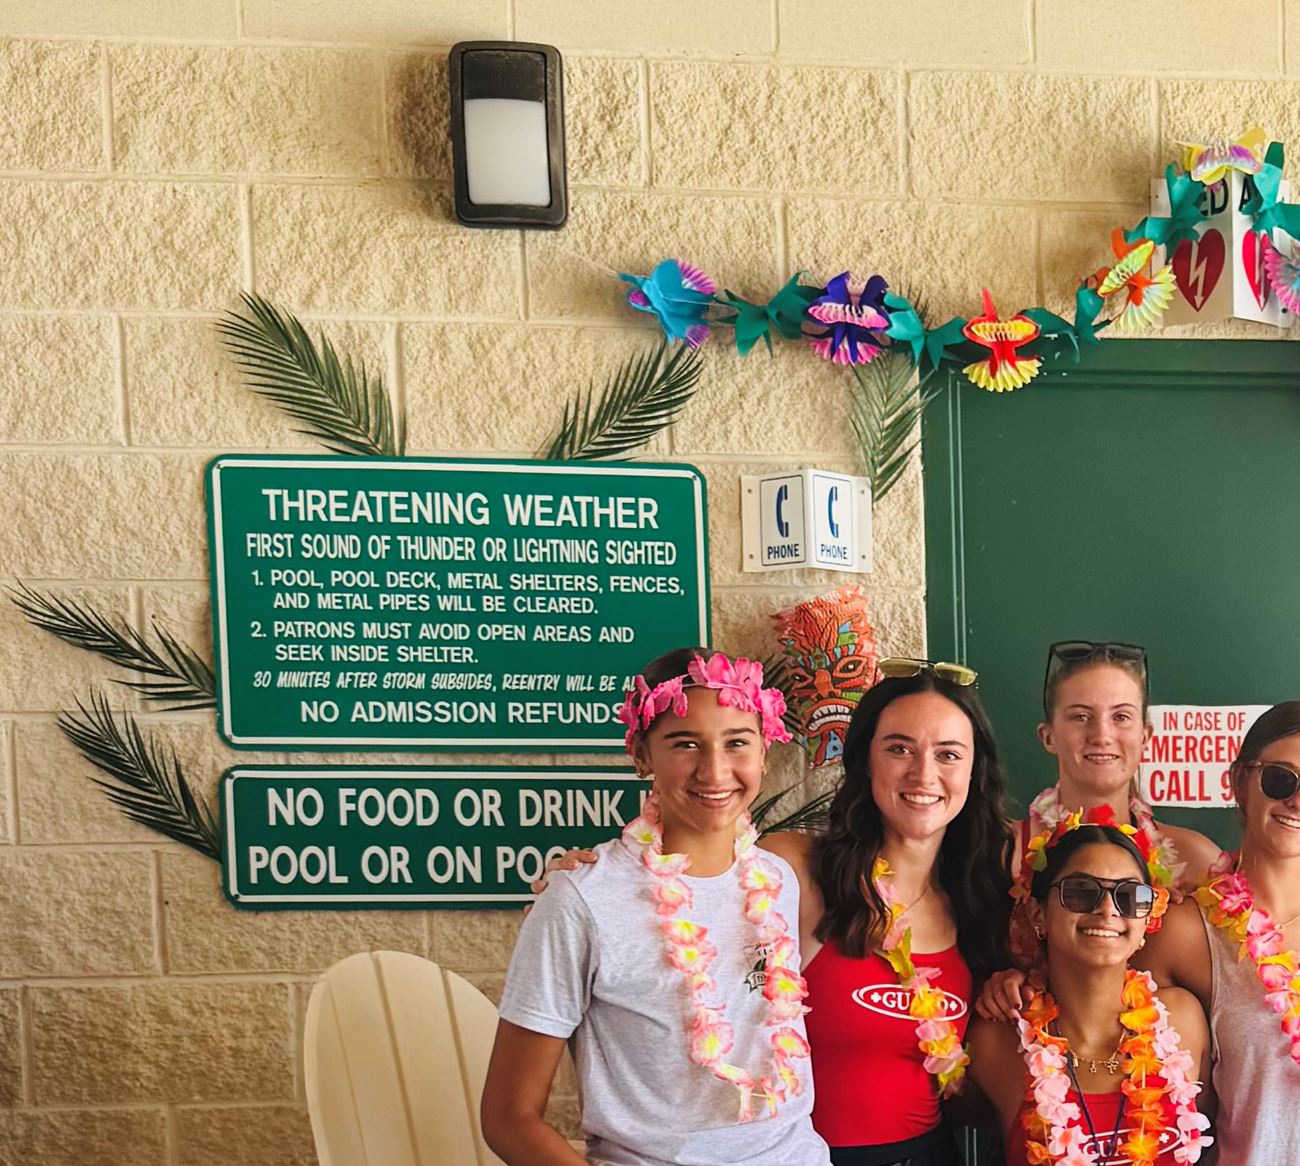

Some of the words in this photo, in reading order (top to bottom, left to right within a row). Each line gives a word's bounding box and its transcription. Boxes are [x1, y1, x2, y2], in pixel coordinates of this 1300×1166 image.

[261, 488, 490, 526] THREATENING
[503, 493, 659, 529] WEATHER
[246, 532, 294, 558] FIRST
[300, 533, 362, 559] SOUND
[367, 534, 391, 560] OF
[396, 535, 476, 561] THUNDER
[482, 537, 508, 562] OR
[513, 537, 599, 564] LIGHTNING
[605, 539, 677, 566] SIGHTED
[767, 543, 800, 560] PHONE
[820, 543, 848, 560] PHONE
[251, 569, 264, 586] 1.
[271, 569, 324, 589] POOL,
[331, 570, 380, 588] POOL
[386, 571, 441, 591] DECK,
[447, 572, 503, 590] METAL
[509, 573, 603, 594] SHELTERS,
[609, 575, 685, 596] FENCES,
[273, 592, 310, 609] AND
[317, 592, 374, 610] METAL
[379, 593, 431, 612] PIPES
[436, 594, 477, 612] WILL
[482, 595, 507, 613] BE
[513, 595, 598, 614] CLEARED.
[250, 620, 267, 638] 2.
[273, 620, 356, 639] PATRONS
[362, 622, 412, 640] MUST
[418, 623, 471, 640] AVOID
[477, 623, 526, 641] OPEN
[532, 625, 592, 643] AREAS
[598, 626, 635, 643] AND
[275, 644, 324, 661] SEEK
[331, 644, 390, 662] INSIDE
[396, 645, 479, 663] SHELTER.
[253, 670, 272, 688] 30
[276, 671, 331, 689] MINUTES
[336, 671, 378, 689] AFTER
[382, 672, 426, 689] STORM
[430, 672, 497, 692] SUBSIDES,
[502, 673, 561, 691] REENTRY
[566, 674, 595, 692] WILL
[598, 675, 617, 692] BE
[301, 700, 340, 723] NO
[350, 700, 497, 723] ADMISSION
[507, 702, 625, 724] REFUNDS
[1162, 711, 1179, 730] IN
[1183, 711, 1220, 732] CASE
[1226, 711, 1244, 732] OF
[1149, 769, 1212, 802] CALL
[267, 787, 324, 827] NO
[338, 787, 440, 827] FOOD
[453, 788, 505, 827] OR
[518, 789, 629, 830] DRINK
[248, 845, 349, 884] POOL
[361, 845, 413, 884] OR
[427, 845, 482, 884] ON
[881, 991, 949, 1011] GUD
